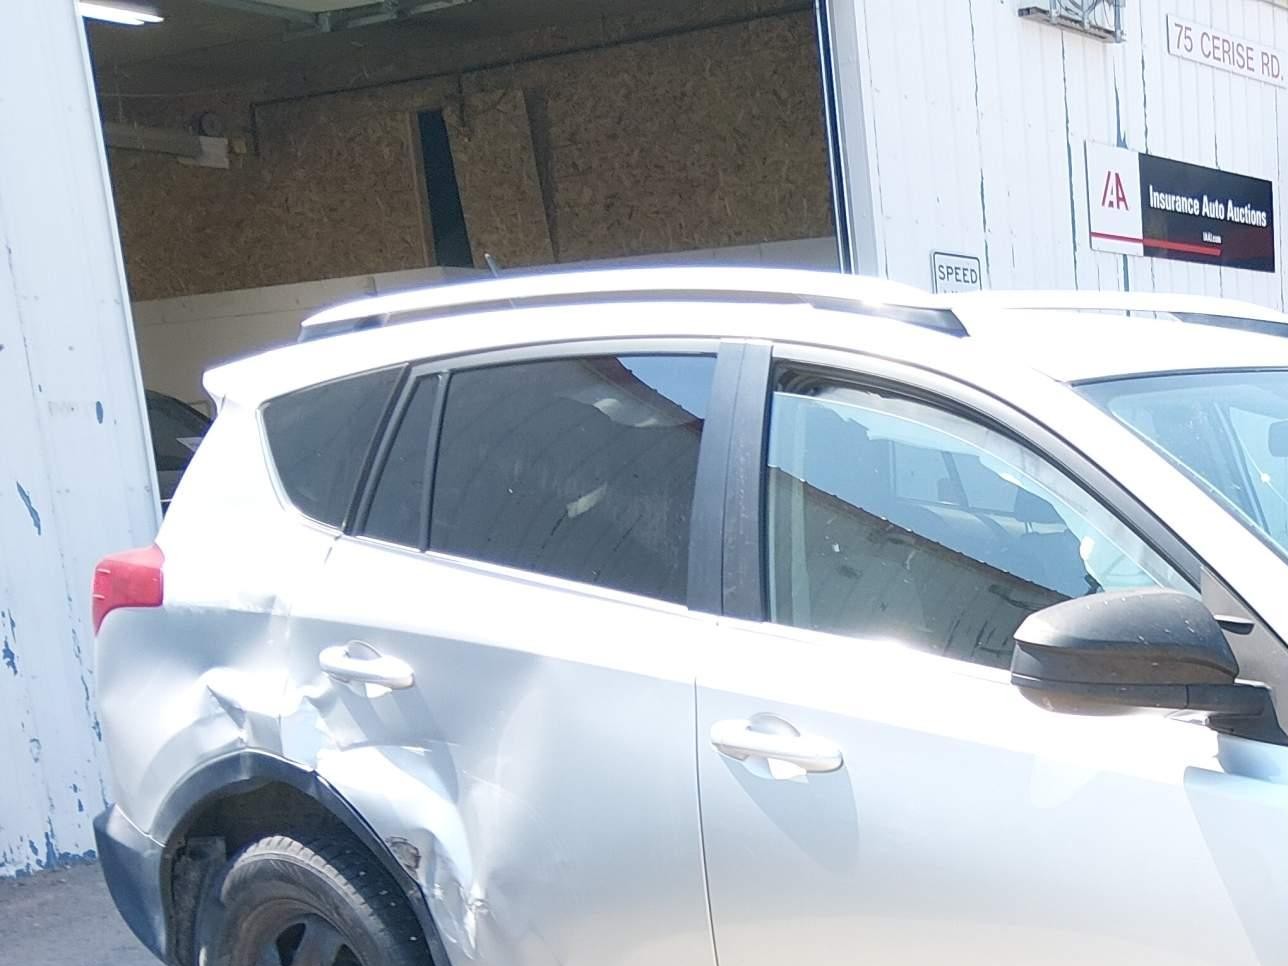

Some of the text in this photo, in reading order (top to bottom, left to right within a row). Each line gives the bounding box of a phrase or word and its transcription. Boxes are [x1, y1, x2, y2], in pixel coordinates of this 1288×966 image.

[1174, 22, 1284, 81] 75 CERISE RD.
[1149, 184, 1267, 228] Insurance Auto Auctions
[938, 265, 978, 284] SPEED
